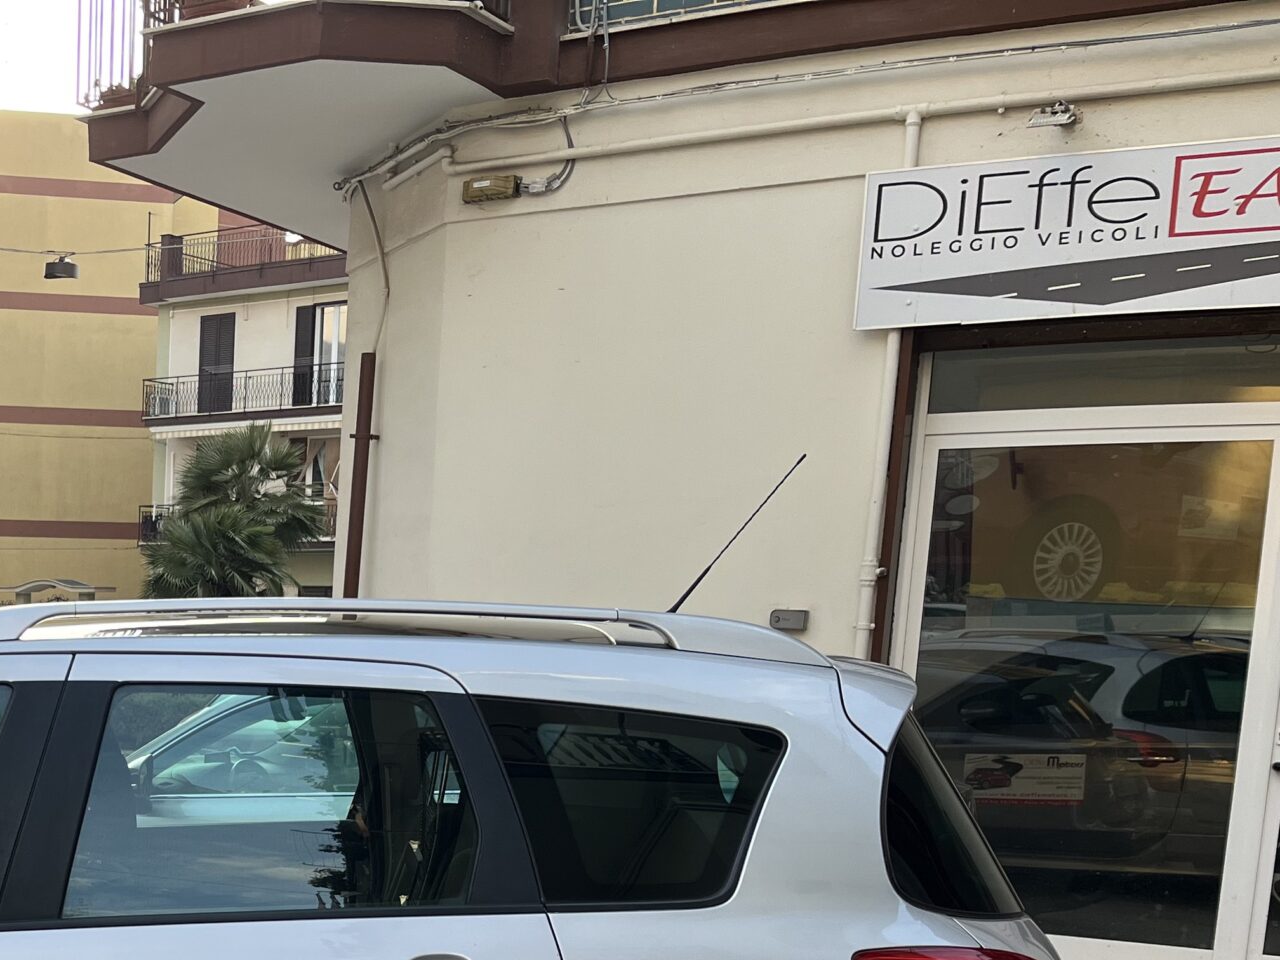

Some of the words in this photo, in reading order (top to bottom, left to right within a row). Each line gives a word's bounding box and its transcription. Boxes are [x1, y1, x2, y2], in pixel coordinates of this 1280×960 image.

[873, 164, 1161, 243] DiEffe
[870, 235, 1018, 260] NOLEGGIO
[1038, 225, 1159, 247] VEICOLI
